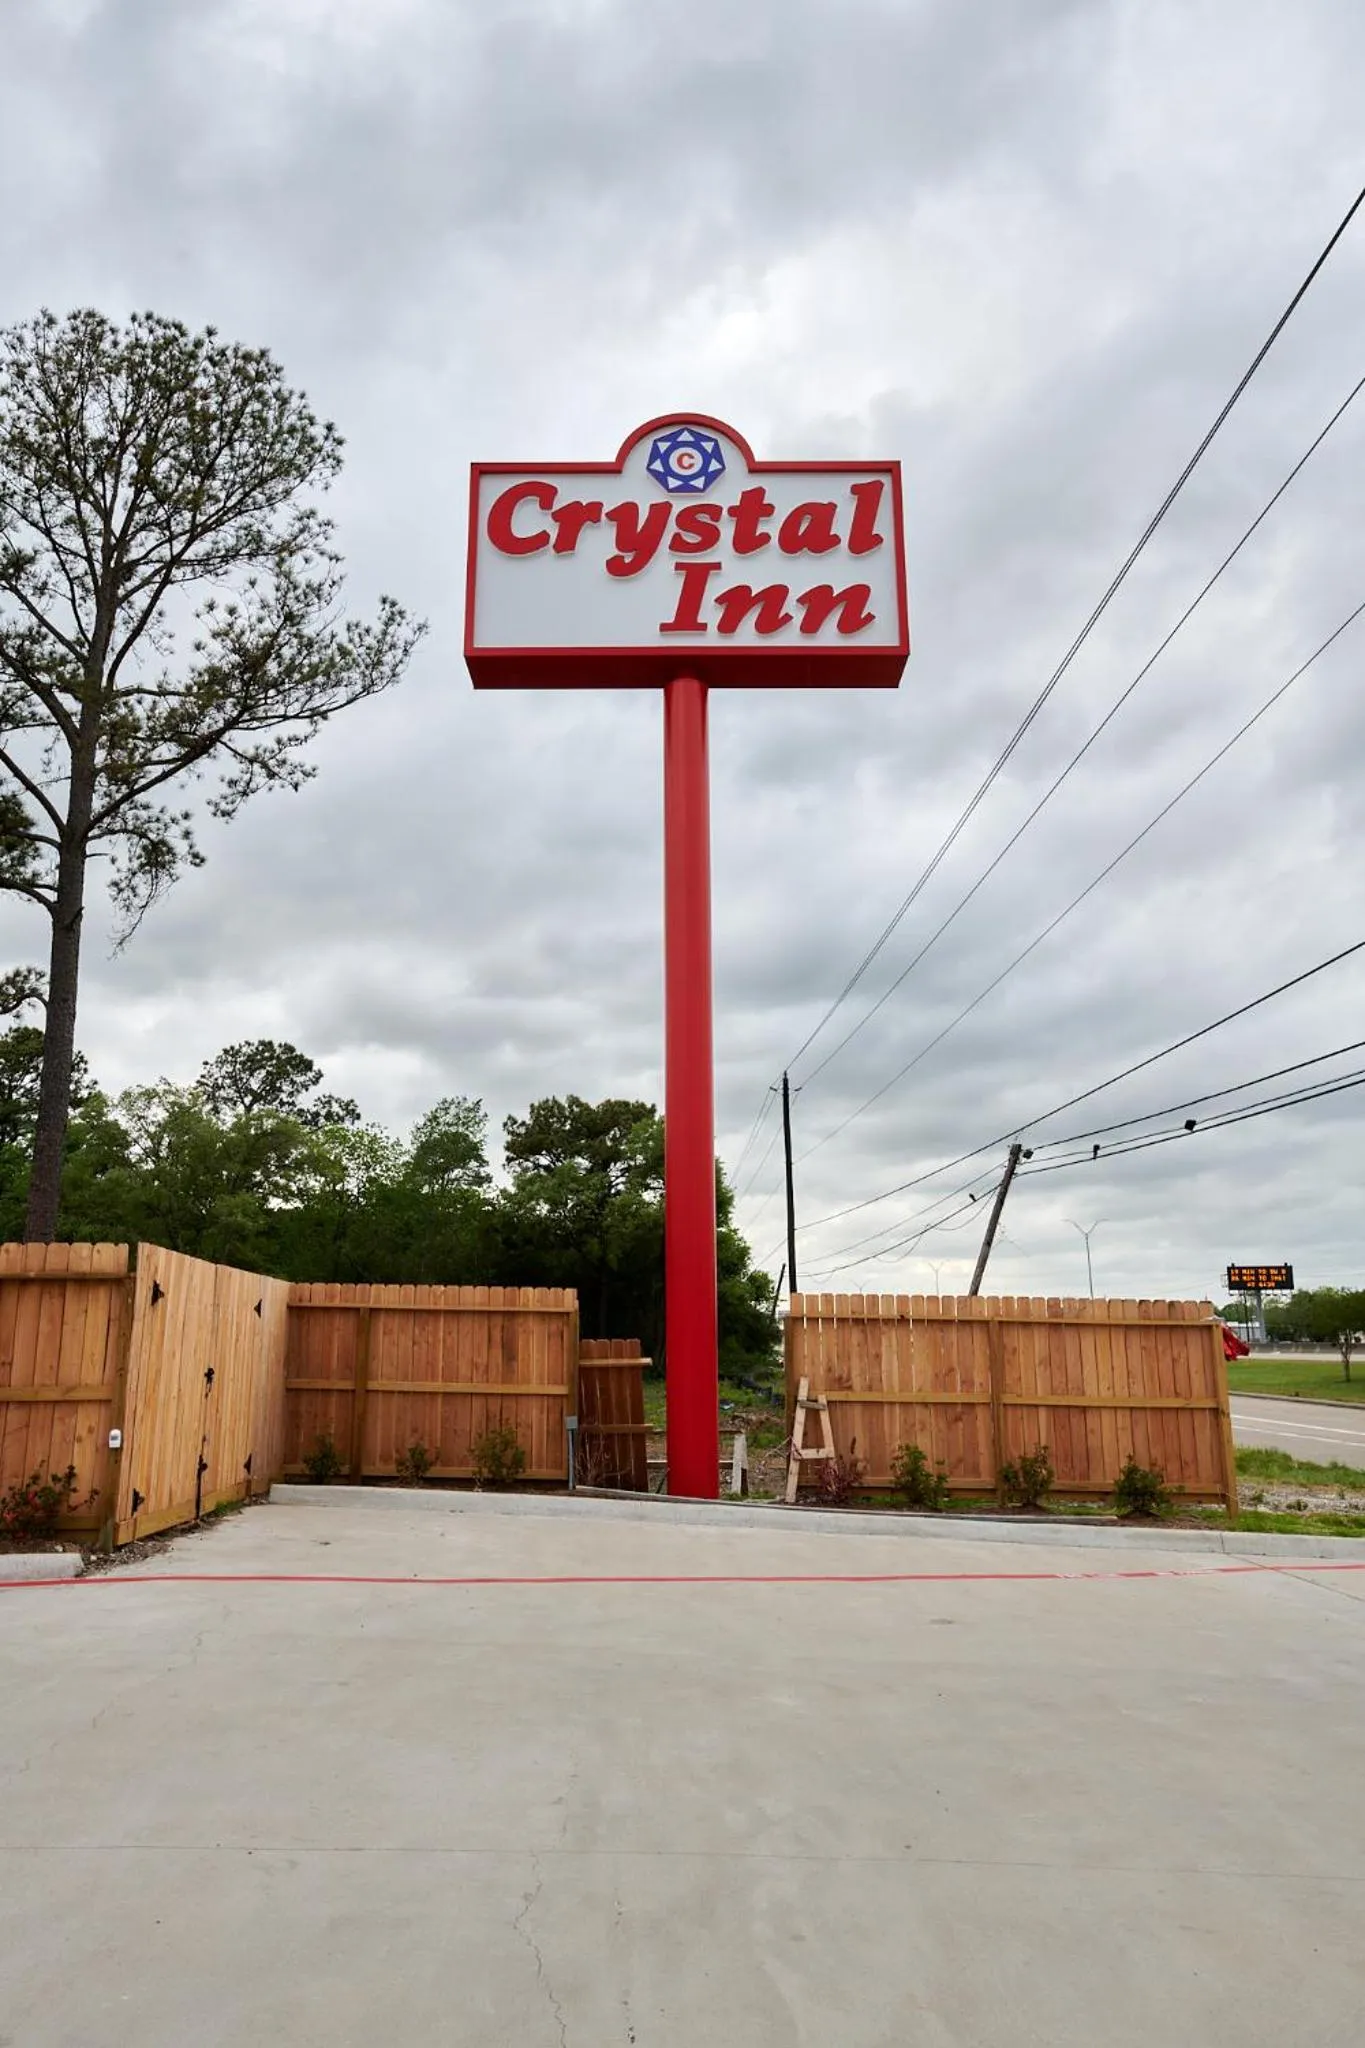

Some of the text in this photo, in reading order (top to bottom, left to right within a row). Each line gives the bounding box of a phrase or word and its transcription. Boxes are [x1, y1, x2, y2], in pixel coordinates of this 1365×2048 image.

[677, 452, 695, 470] C
[487, 480, 884, 577] Crystal
[659, 562, 876, 635] Inn
